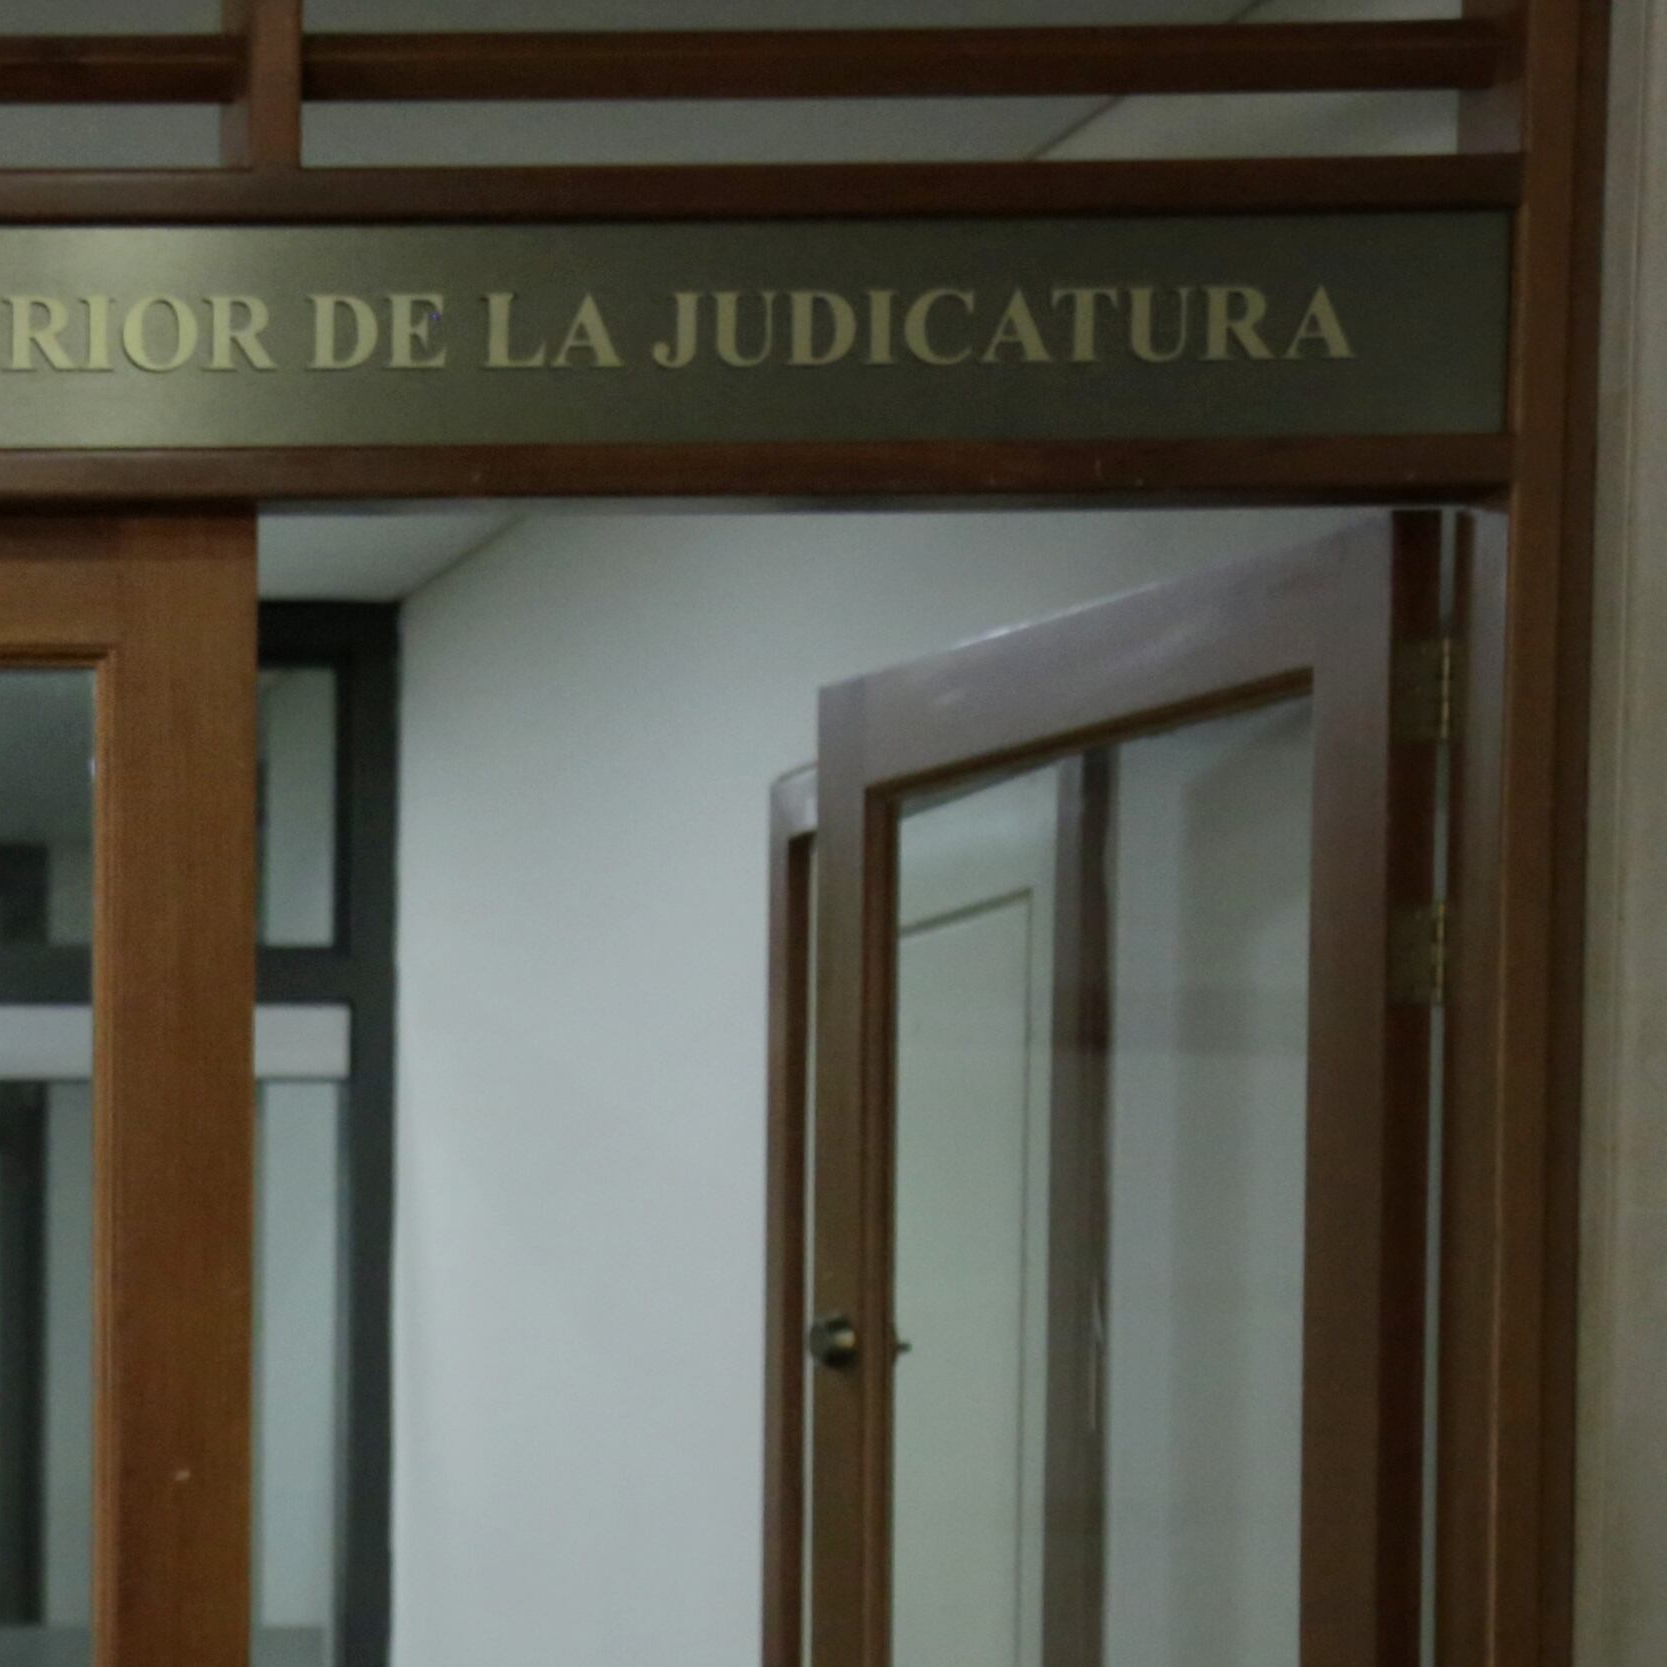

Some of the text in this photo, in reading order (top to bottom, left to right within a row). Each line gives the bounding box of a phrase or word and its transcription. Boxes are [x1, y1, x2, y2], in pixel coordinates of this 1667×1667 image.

[307, 291, 448, 370] DE
[481, 291, 626, 370] LA
[652, 286, 1358, 369] JUDICATURA
